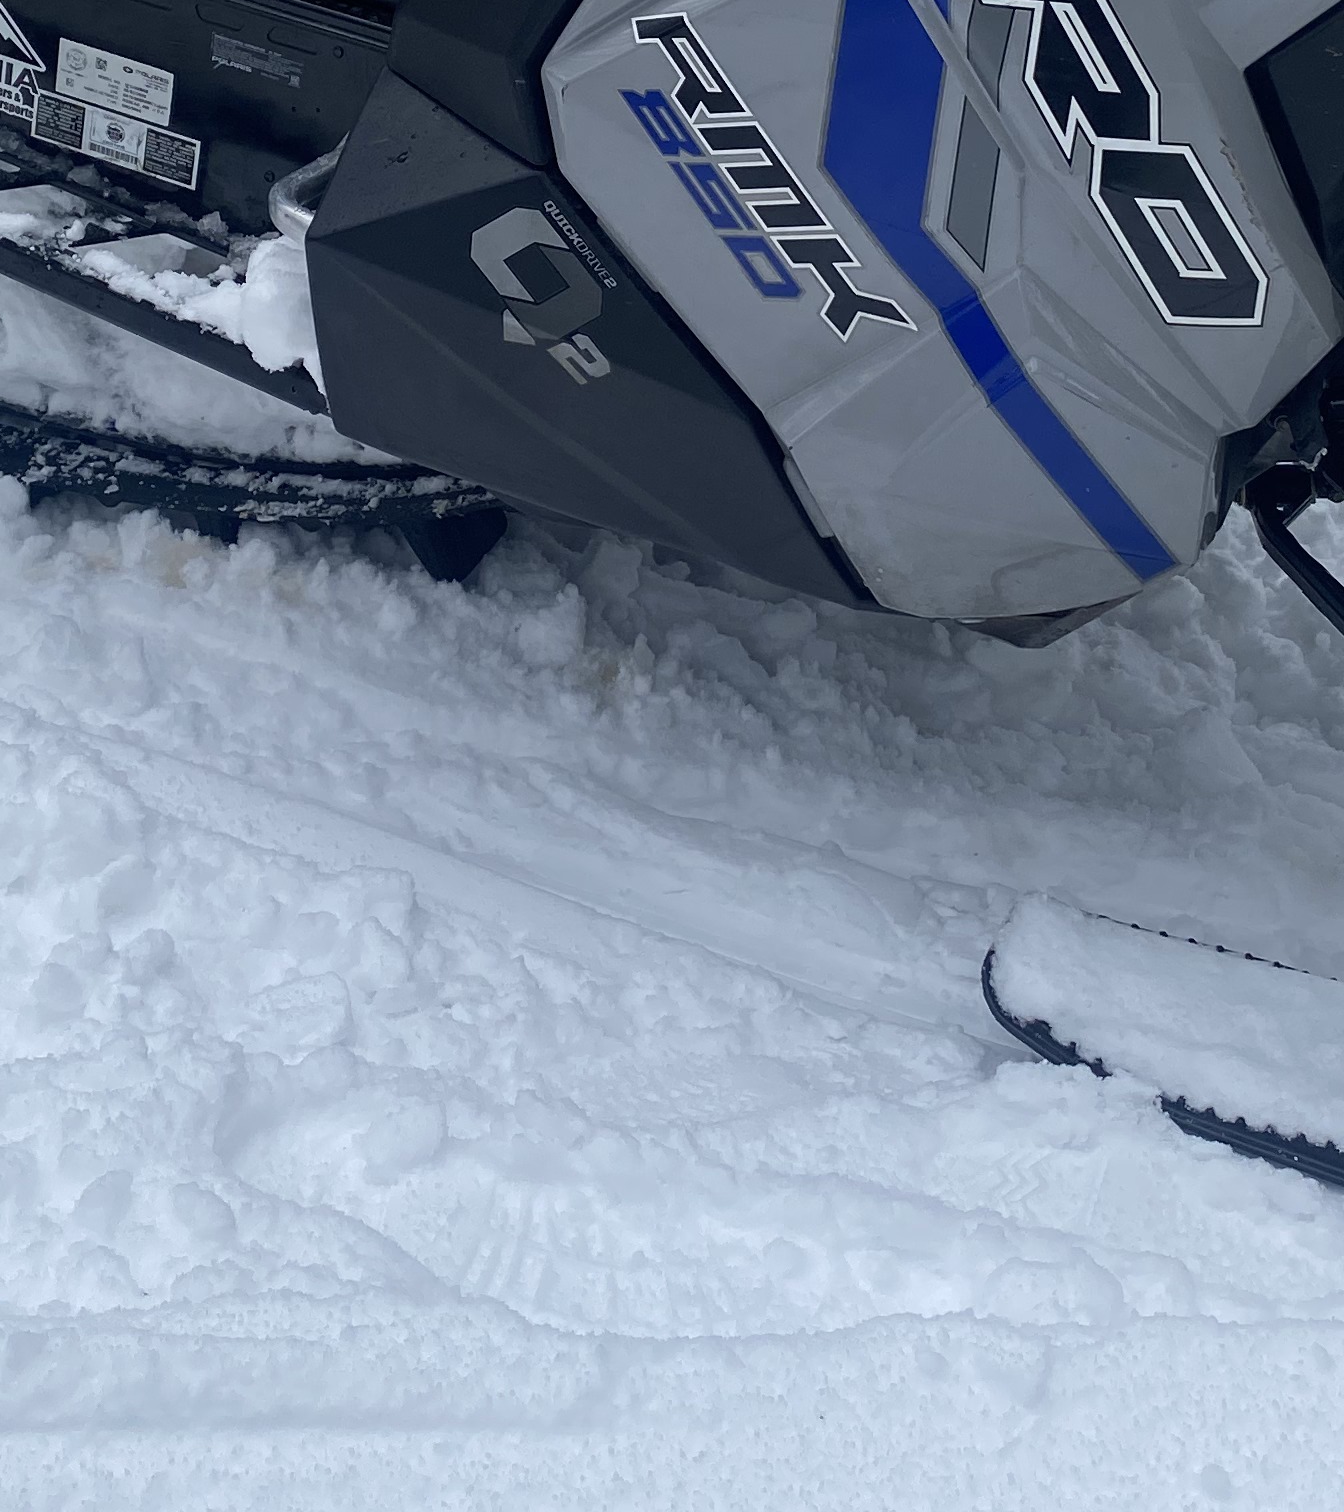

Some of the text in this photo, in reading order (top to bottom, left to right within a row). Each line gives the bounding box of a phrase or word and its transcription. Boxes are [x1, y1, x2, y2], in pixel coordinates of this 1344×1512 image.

[13, 92, 21, 103] &
[617, 89, 806, 302] 850
[631, 12, 918, 343] RMK
